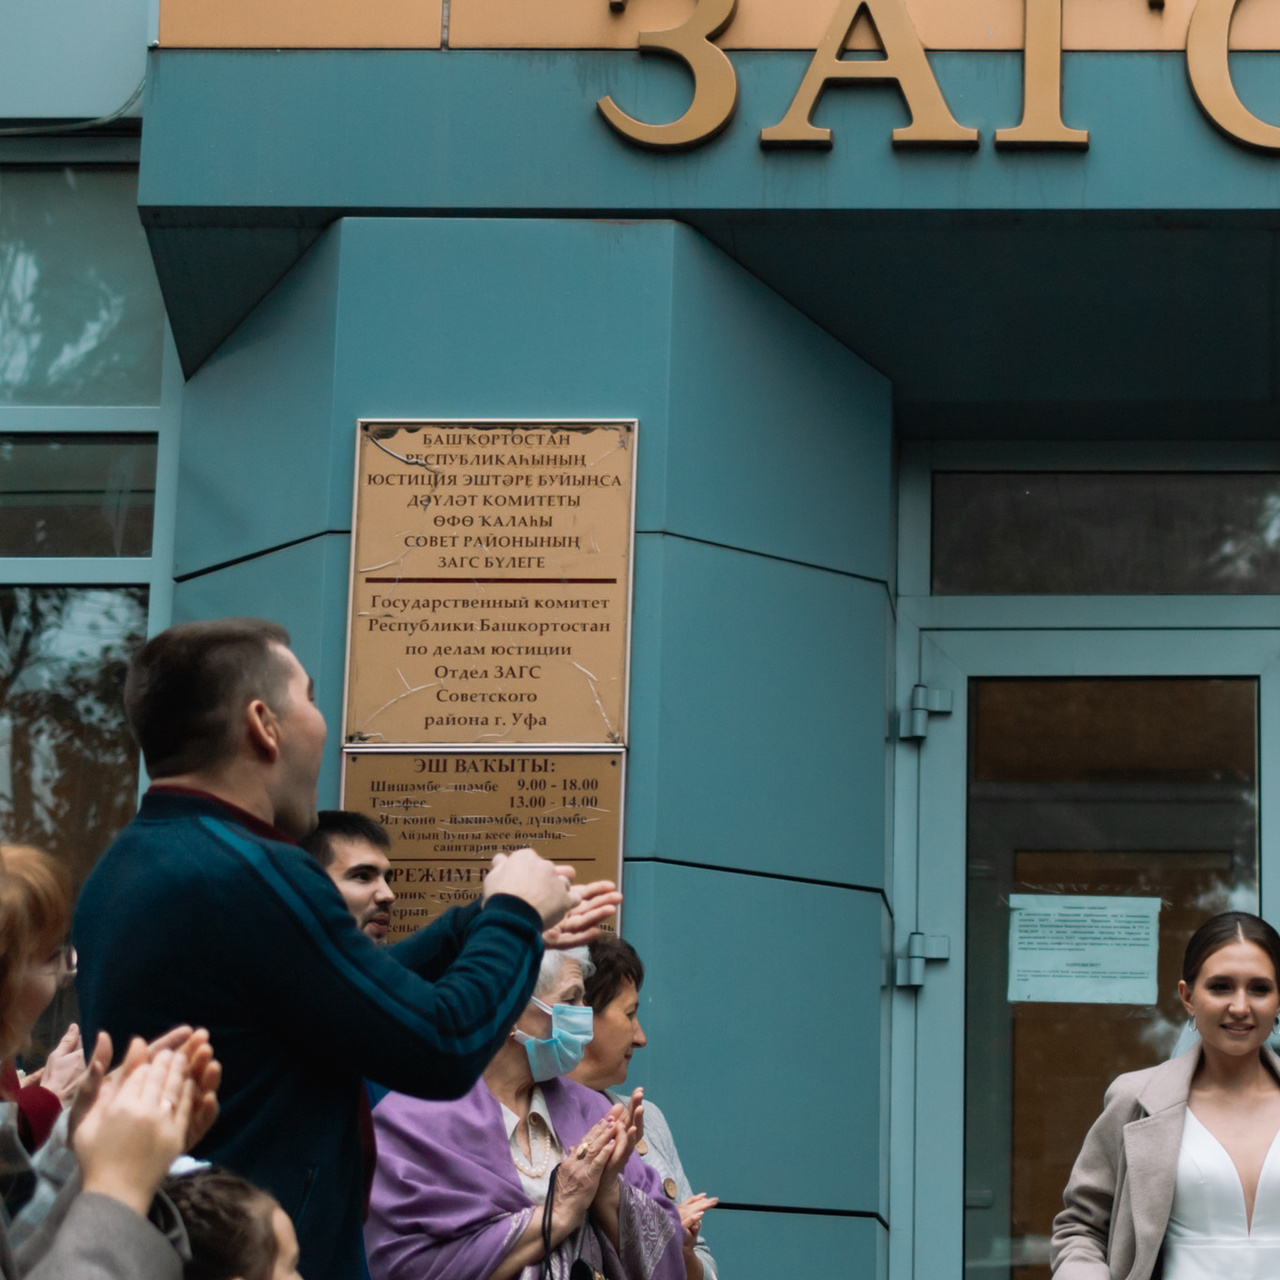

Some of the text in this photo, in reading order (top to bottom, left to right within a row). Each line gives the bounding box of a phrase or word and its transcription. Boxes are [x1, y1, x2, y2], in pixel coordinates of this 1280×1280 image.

[367, 473, 621, 487] ЮСТИЦИЯ ЭШТӘРЕ БУЙЫНСА
[483, 495, 581, 506] КОМИТЕТЫ
[433, 515, 474, 527] ӨФӨ
[404, 533, 580, 549] СОВЕТ РАЙОНЫНЫҢ
[437, 557, 480, 568] ЗАГС
[371, 595, 610, 611] Государственный комитет
[368, 619, 611, 636] Республики Башкортостан
[405, 645, 572, 657] по делам юстиции
[434, 666, 541, 680] Отдел ЗАГС
[436, 690, 537, 703] Советского
[424, 713, 547, 730] района г. Уфа
[413, 759, 448, 773] ЭШ
[518, 780, 547, 791] 9.00
[562, 779, 598, 791] 18.00
[509, 797, 546, 808] 13.00
[561, 796, 598, 808] 14.00
[393, 868, 472, 882] РЕЖИМ
